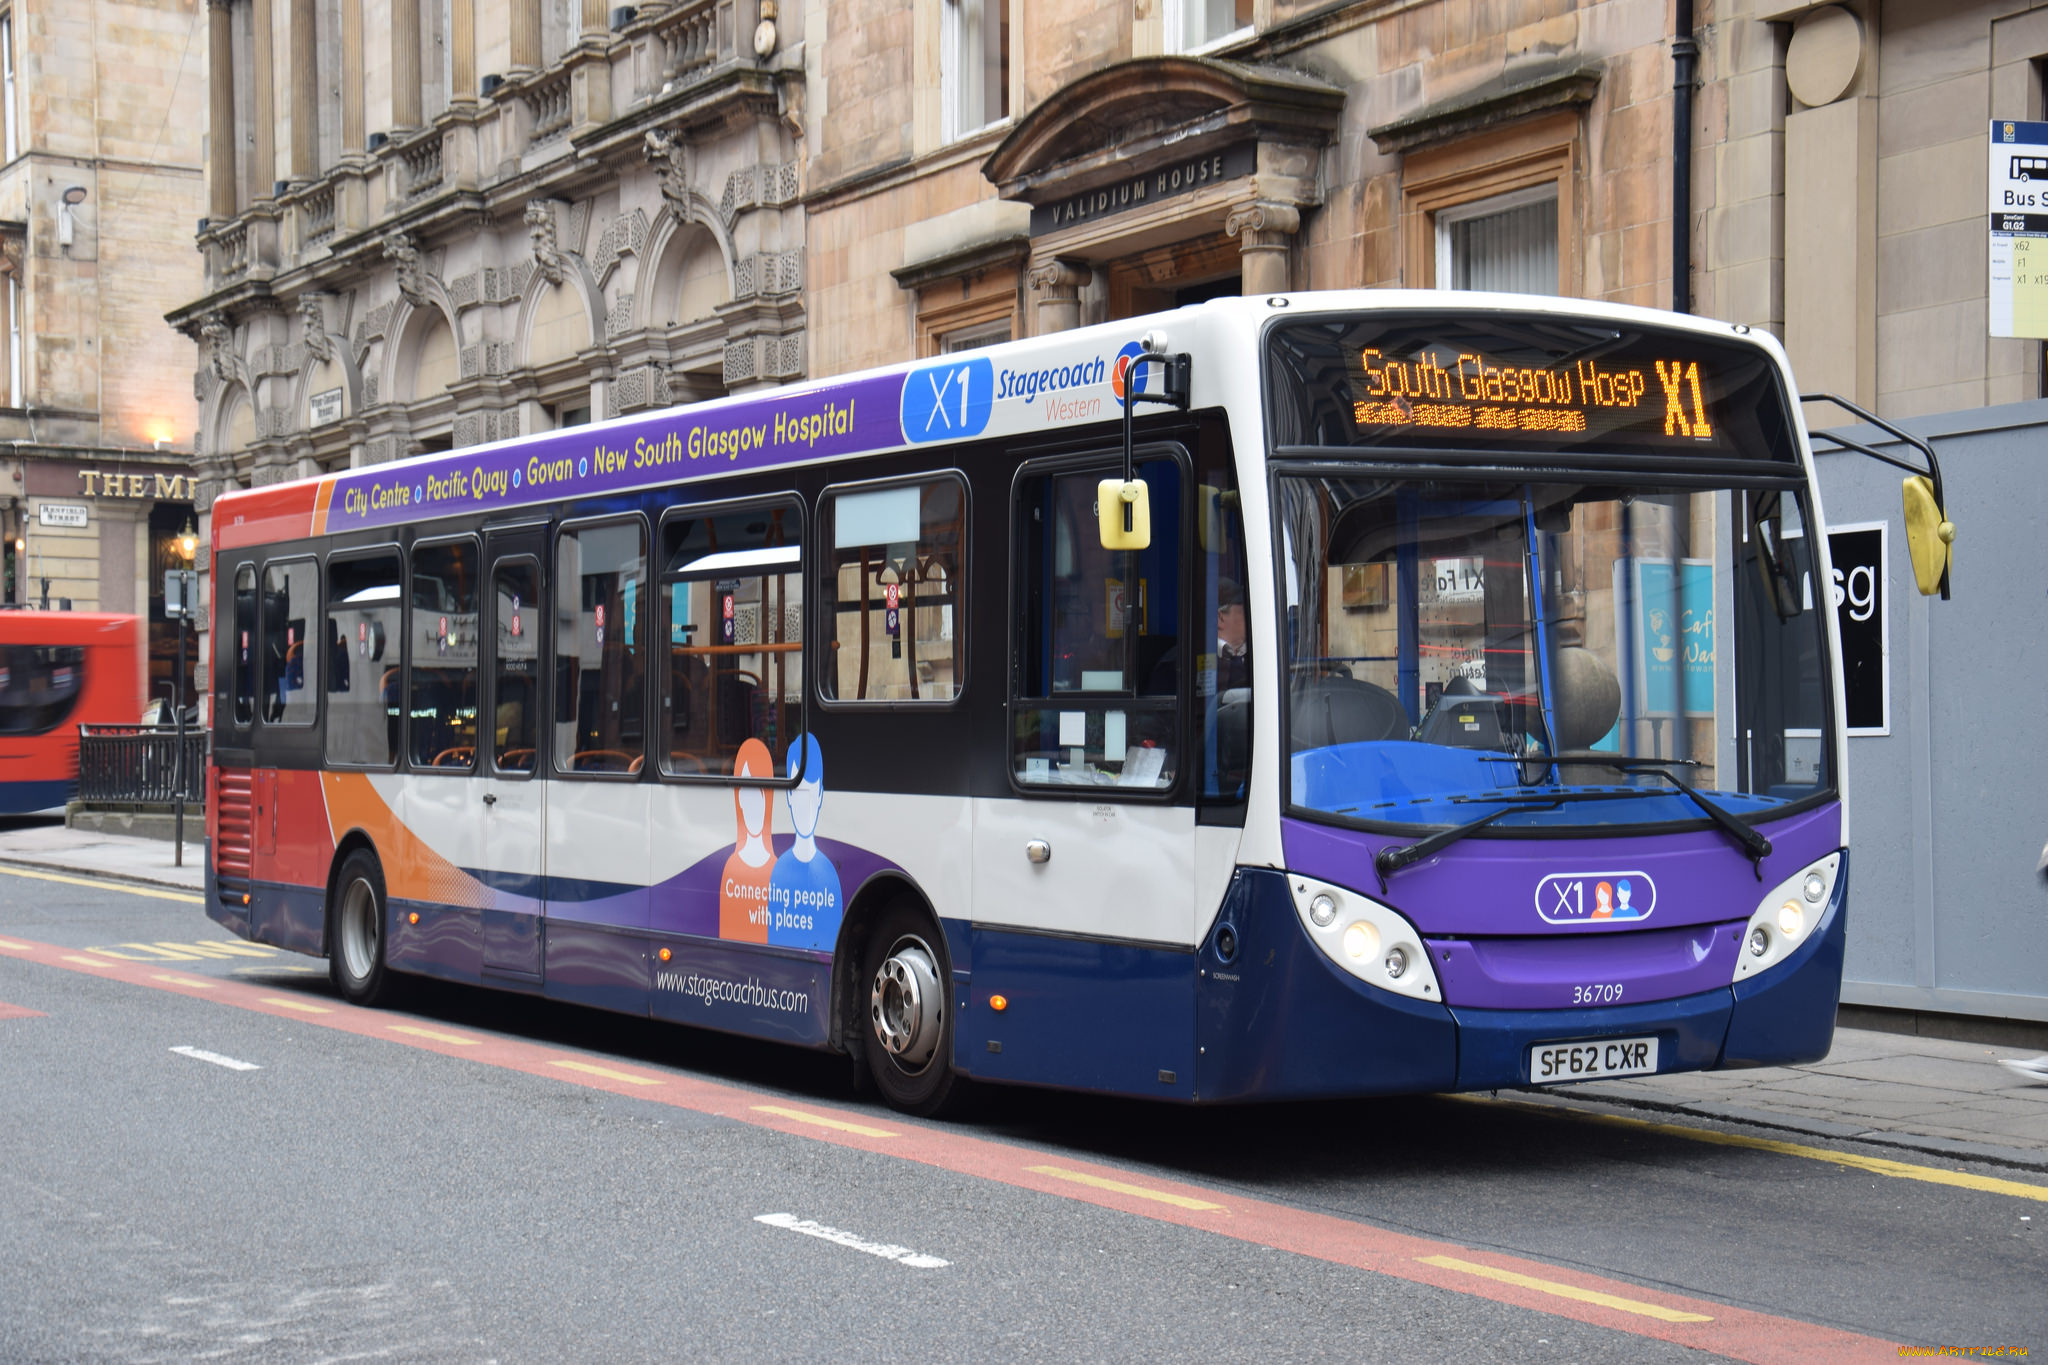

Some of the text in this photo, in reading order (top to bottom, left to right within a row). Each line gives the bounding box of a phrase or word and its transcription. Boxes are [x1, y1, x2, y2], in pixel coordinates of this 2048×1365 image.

[1053, 156, 1222, 224] VALIDIUM HOUSE
[2004, 190, 2035, 206] Bus
[997, 355, 1105, 404] Stagecoach
[1363, 349, 1644, 407] South Glasgow Hosp
[925, 366, 970, 432] X1
[1045, 397, 1101, 423] Western
[1655, 360, 1712, 437] X1
[345, 398, 854, 517] City Centre Pacific Quay Govan New South Glasgow Hospital
[78, 470, 145, 498] THE
[725, 878, 835, 911] Connecting people
[1553, 881, 1584, 915] X1
[749, 904, 813, 931] with places
[657, 971, 808, 1013] www.stagecoachbus.com
[1573, 984, 1623, 1004] 36709
[1541, 1042, 1649, 1077] SF62 CXR
